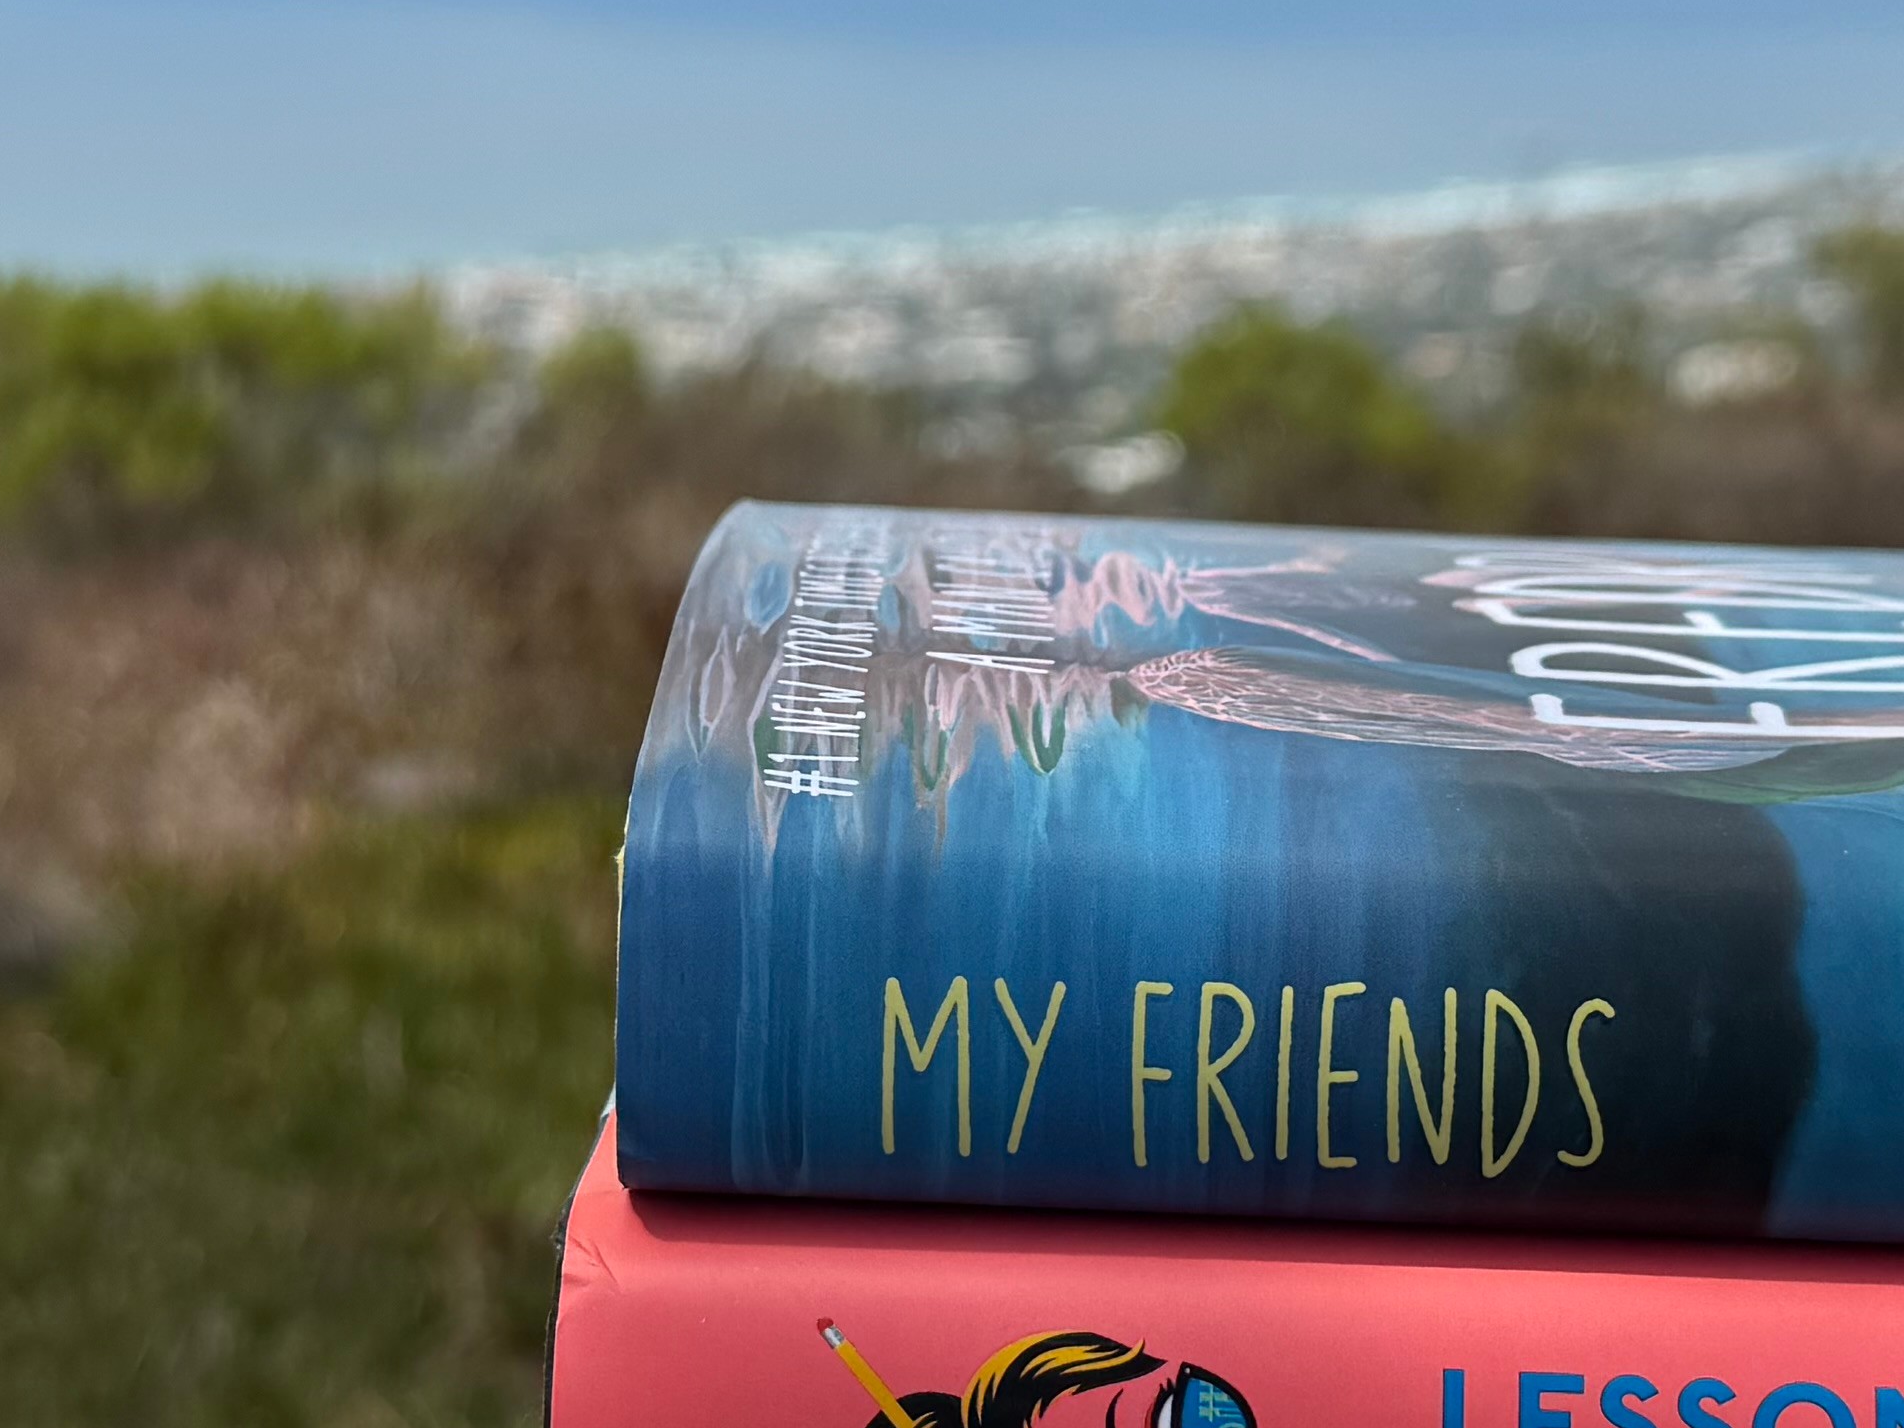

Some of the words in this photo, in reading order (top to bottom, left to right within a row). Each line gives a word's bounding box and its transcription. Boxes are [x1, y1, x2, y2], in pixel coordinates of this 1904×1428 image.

[931, 580, 1056, 641] MAN
[783, 614, 879, 673] YORK
[926, 650, 1056, 674] A
[770, 679, 866, 738] NEW
[764, 753, 859, 796] #1
[880, 975, 1068, 1157] MY
[1130, 978, 1617, 1179] FRIENDS
